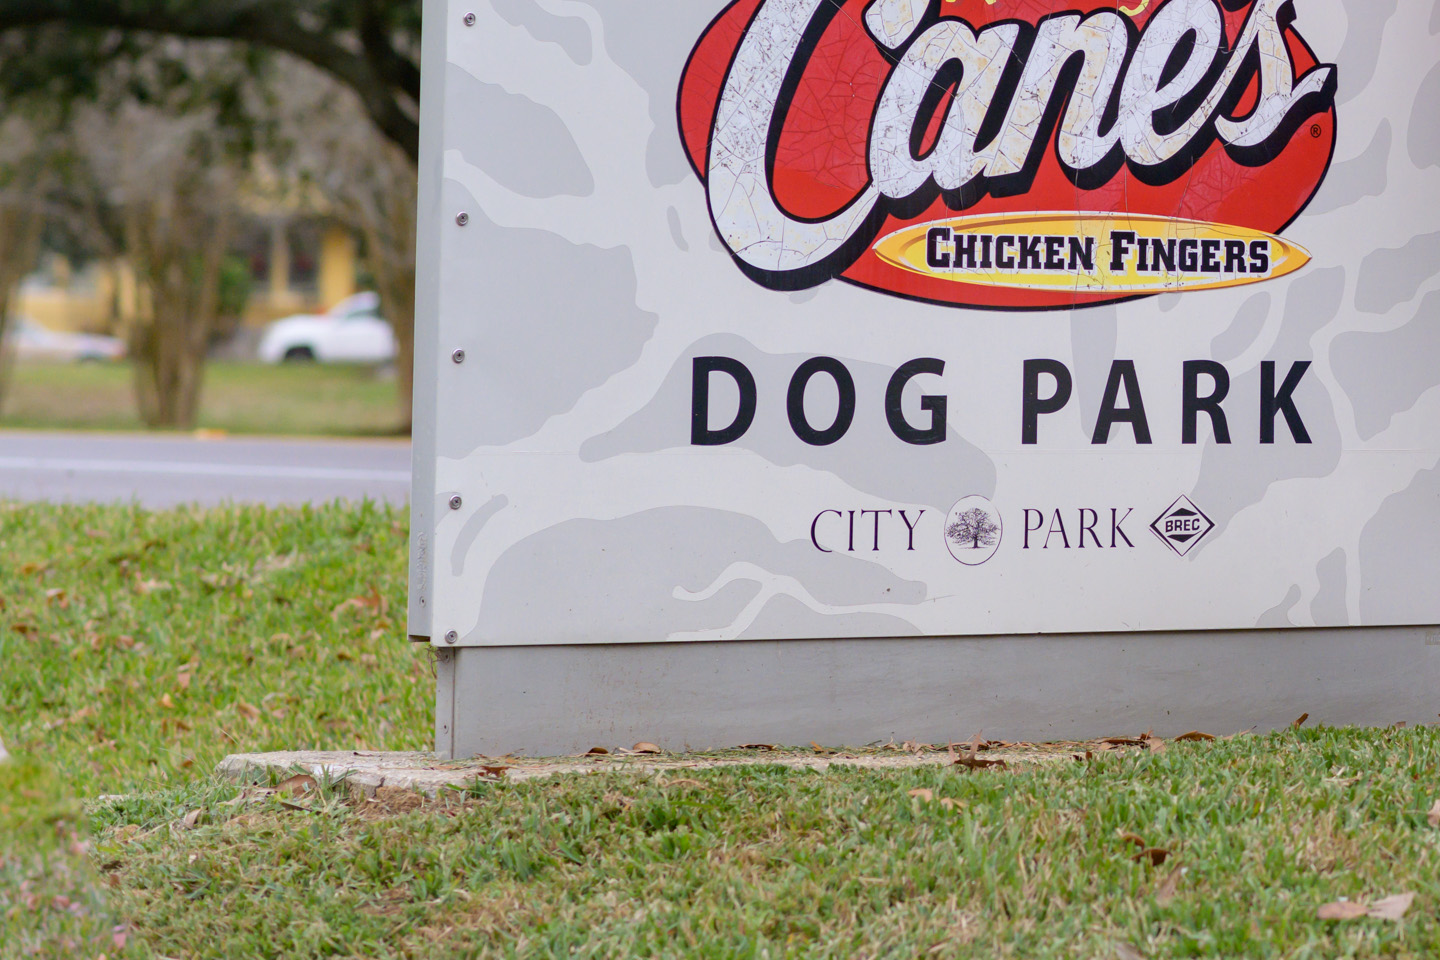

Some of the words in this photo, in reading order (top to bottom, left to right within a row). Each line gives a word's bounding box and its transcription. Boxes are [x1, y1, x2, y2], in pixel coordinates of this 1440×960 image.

[925, 225, 1095, 272] CHICKEN
[1109, 228, 1270, 275] FINGERS
[690, 355, 948, 447] DOG
[1021, 358, 1313, 445] PARK
[810, 508, 926, 553] CITY
[1022, 507, 1135, 549] PARK
[1165, 517, 1200, 533] BREC
